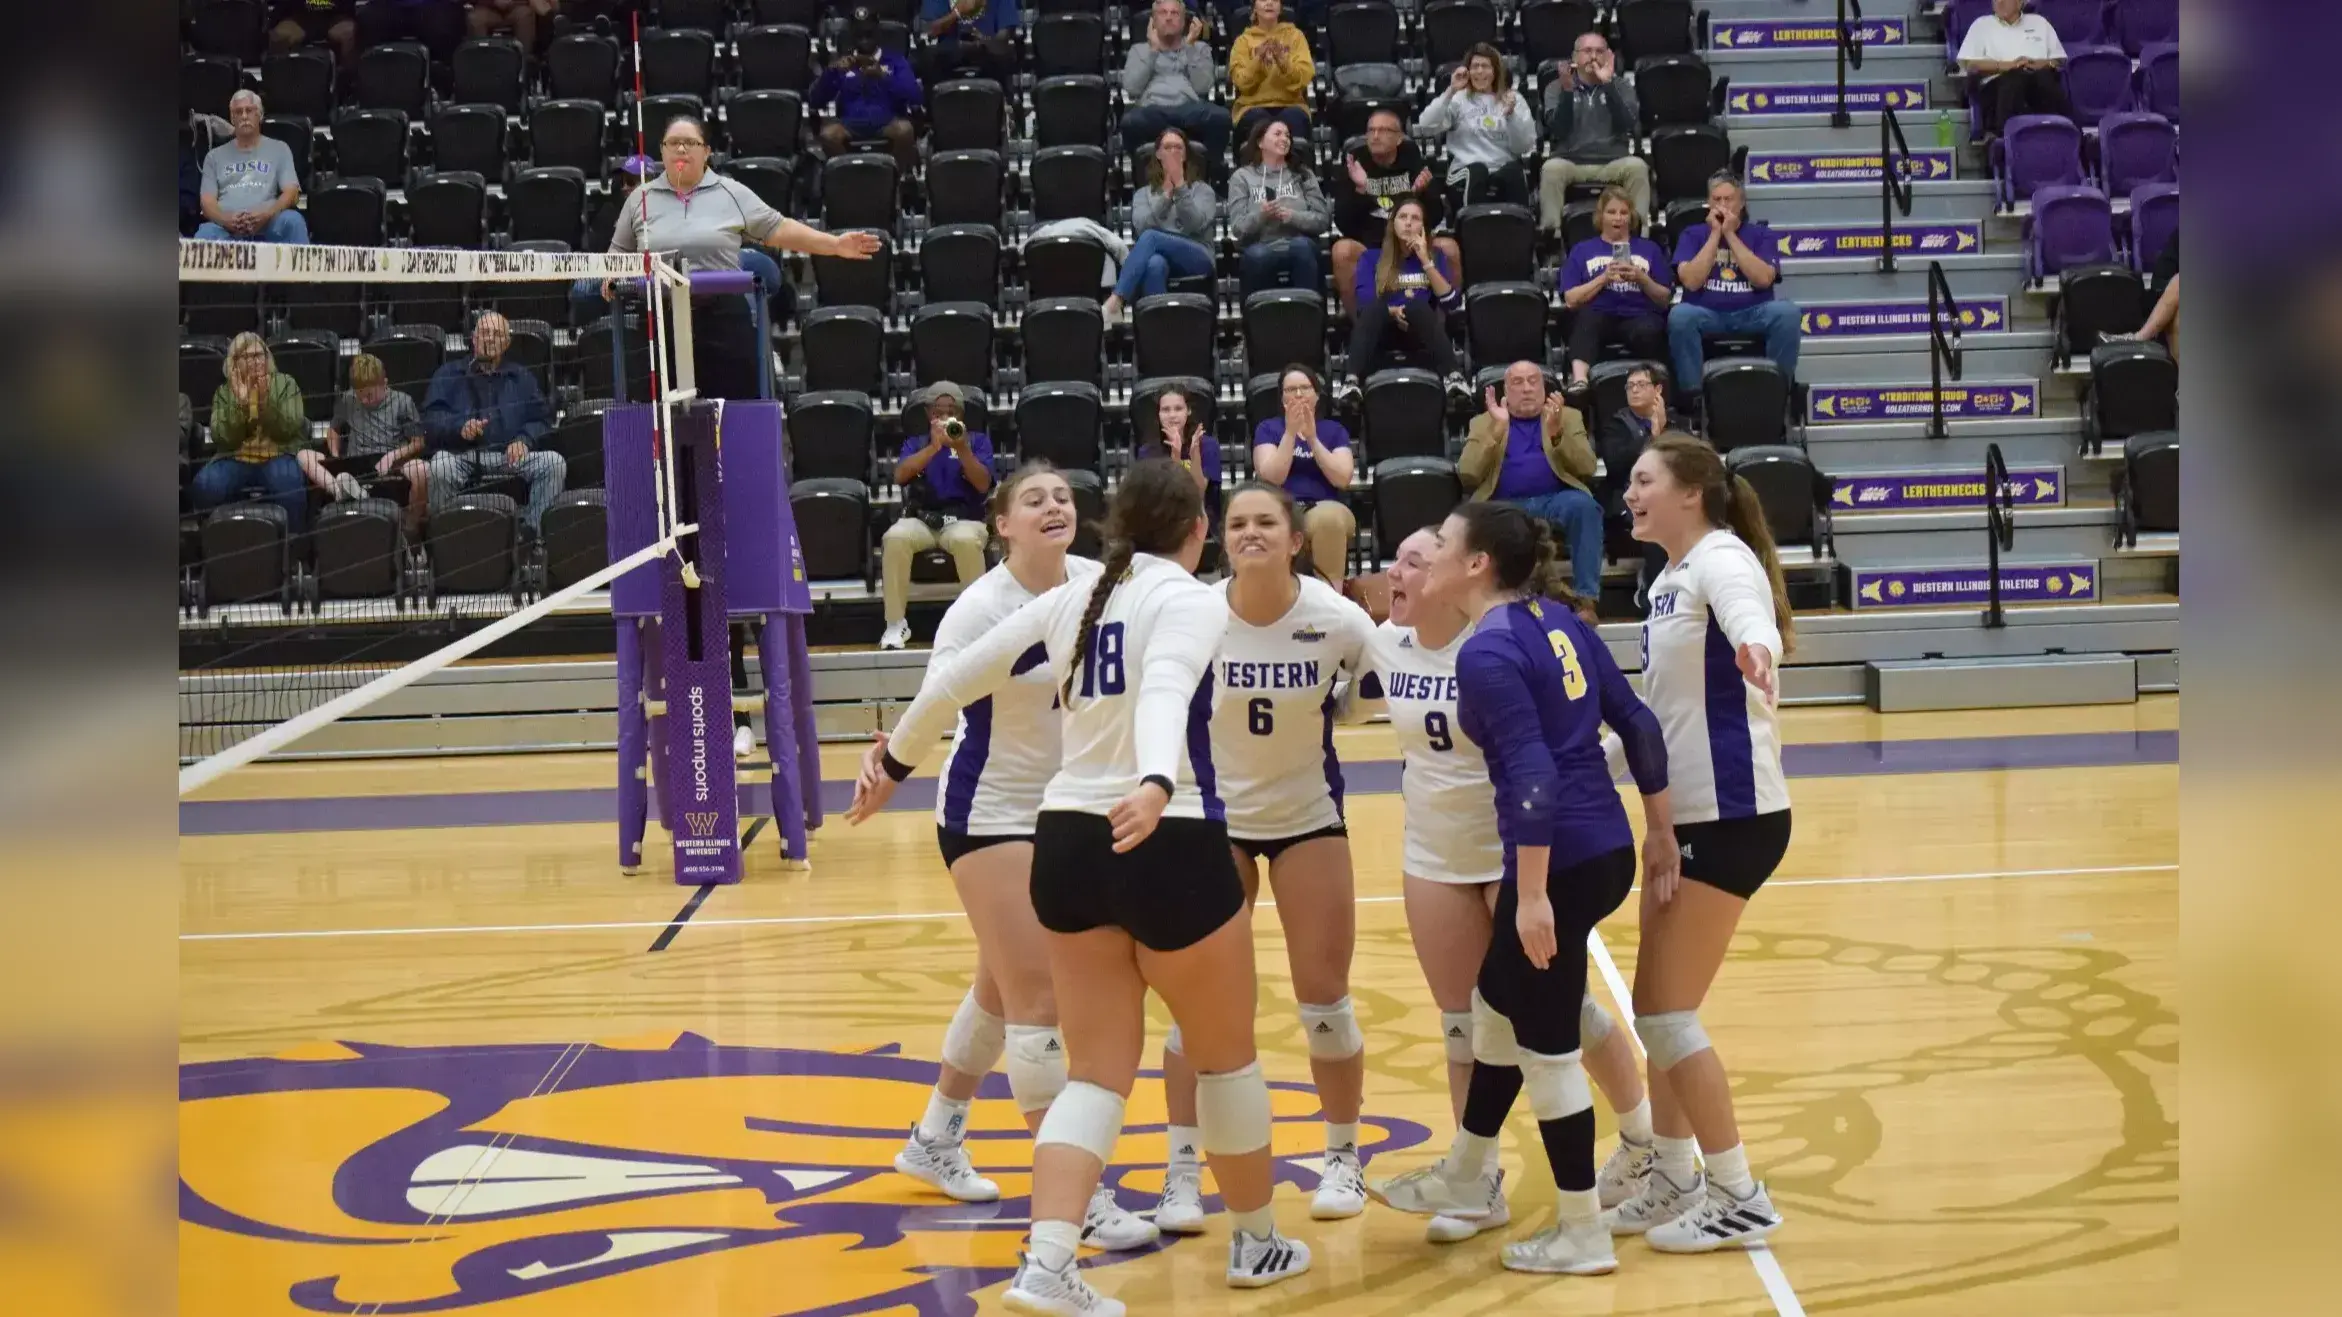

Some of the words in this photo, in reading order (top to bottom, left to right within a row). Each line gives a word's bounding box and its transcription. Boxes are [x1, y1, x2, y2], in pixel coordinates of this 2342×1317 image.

[1774, 29, 1840, 41] LEATHERNECK
[1775, 95, 1809, 105] WESTERN
[225, 161, 269, 175] SDSU
[1810, 157, 1883, 169] #TRADITIONOFTOU
[1836, 235, 1913, 249] LEATHERCKS
[1704, 279, 1754, 293] OLLEYBALL
[1839, 314, 1876, 326] WESTERN
[1878, 313, 1911, 324] ILLINOIS
[1912, 312, 1952, 323] ATHTIC
[1879, 391, 1967, 403] #TRADITIONTOUGH
[1885, 403, 1962, 414] GOLEATHERNECS.COM
[1903, 483, 1987, 498] LEATHERNECKS
[1912, 581, 1954, 593] WESTERN
[1955, 580, 1991, 592] ILLINOIS
[1999, 578, 2040, 590] THLETICS
[1080, 621, 1126, 697] 18
[1548, 629, 1588, 701] 3
[1390, 672, 1457, 701] WESTE
[688, 686, 705, 737] sports
[1248, 697, 1273, 736] 6
[1424, 711, 1454, 751] 9
[692, 737, 709, 801] imports
[676, 839, 705, 848] WESTERN
[705, 838, 731, 847] ILLINOIS
[686, 848, 721, 856] UNIVERSITY
